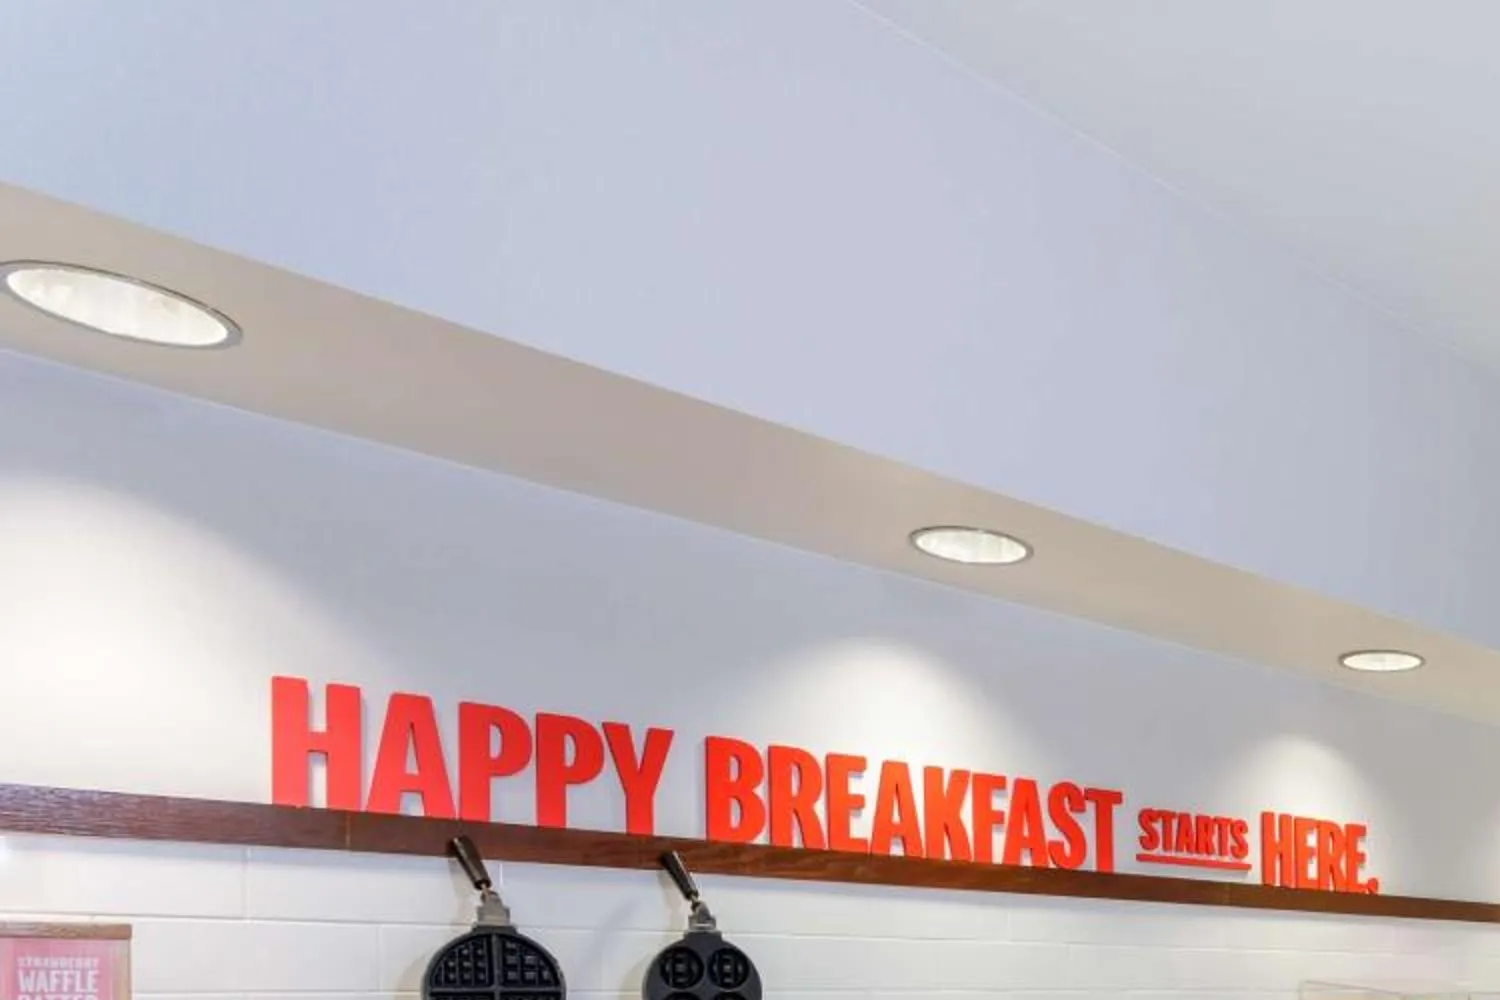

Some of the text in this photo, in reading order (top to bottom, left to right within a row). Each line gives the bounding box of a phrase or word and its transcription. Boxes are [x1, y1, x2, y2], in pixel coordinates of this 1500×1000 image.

[271, 676, 1379, 895] HAPPY BREAKFAST STARTS HERE.
[18, 969, 100, 993] WAFFLE
